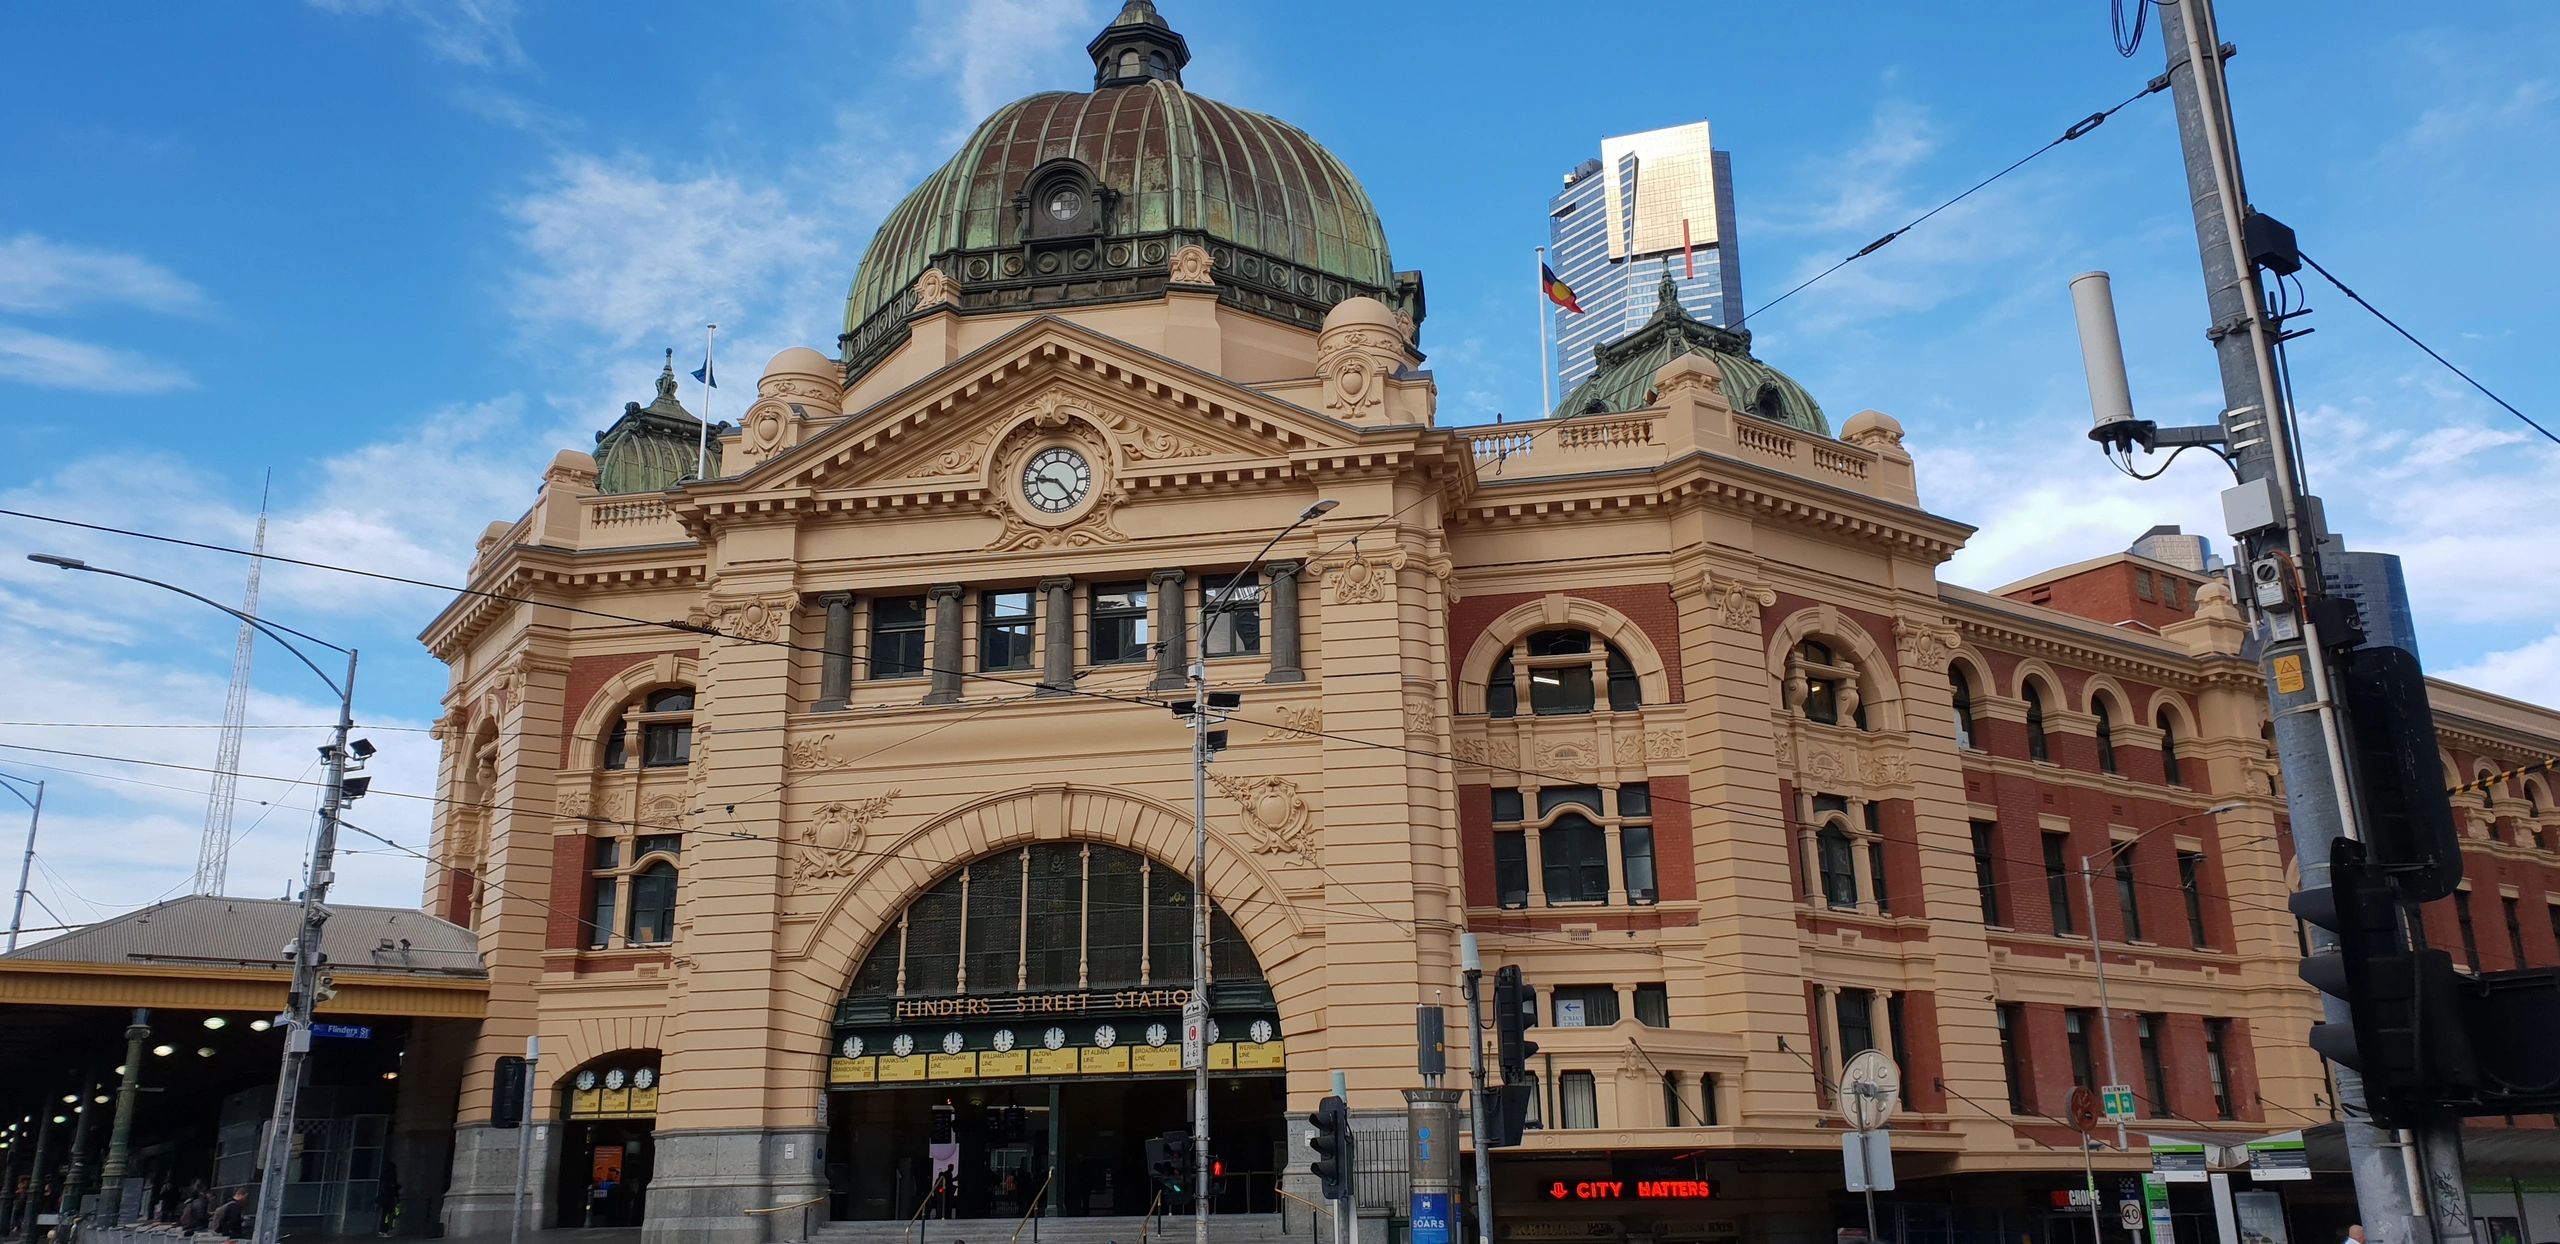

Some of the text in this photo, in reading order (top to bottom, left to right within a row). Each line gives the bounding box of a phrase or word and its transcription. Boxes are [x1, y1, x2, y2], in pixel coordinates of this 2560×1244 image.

[896, 989, 1194, 1017] FLINDERS STREET STATIO
[328, 1025, 358, 1034] Flinders
[360, 1027, 369, 1035] St
[1576, 1182, 1710, 1198] CITY HATTERS
[2124, 1209, 2139, 1220] 40
[1413, 1220, 1445, 1228] SOARS
